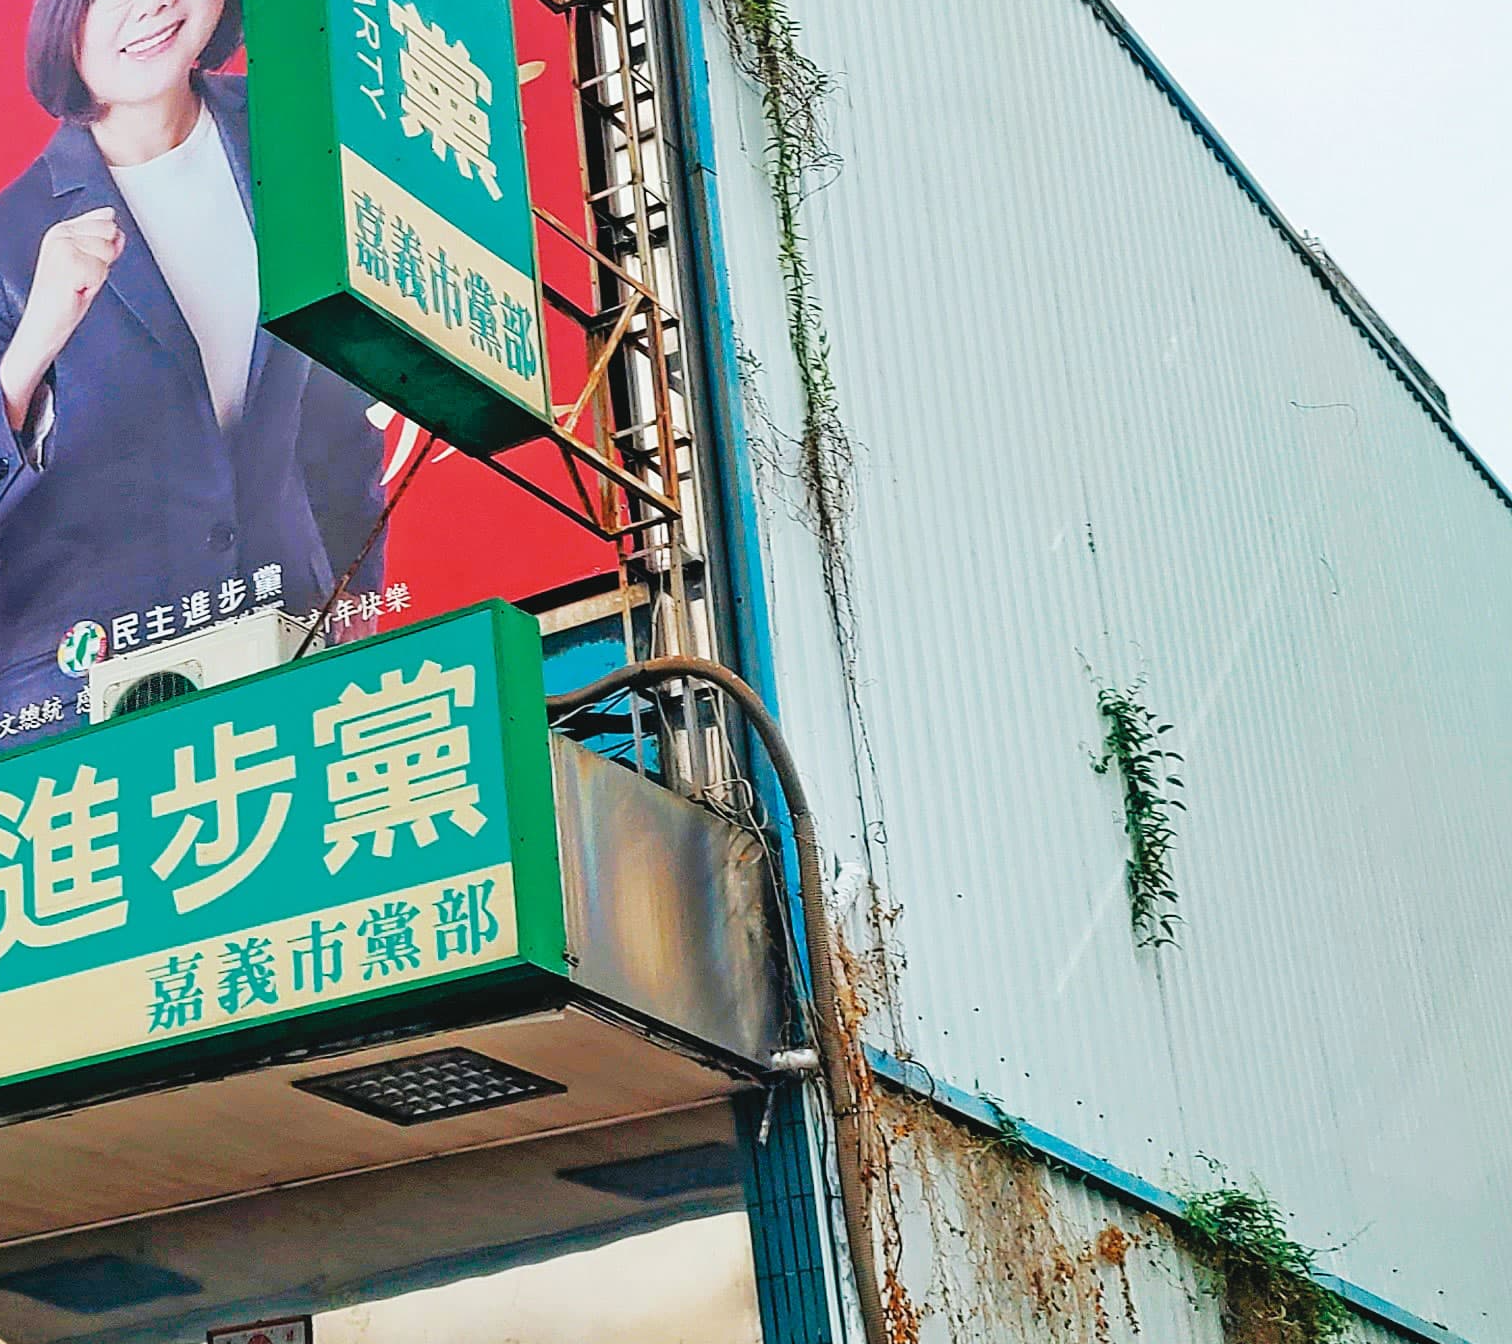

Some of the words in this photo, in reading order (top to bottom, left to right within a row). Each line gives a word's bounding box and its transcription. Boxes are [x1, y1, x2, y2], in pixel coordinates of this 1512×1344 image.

[351, 189, 537, 382] 嘉義市黨部
[111, 563, 283, 651] 民主進步黨
[144, 877, 500, 1035] 嘉義市黨部
